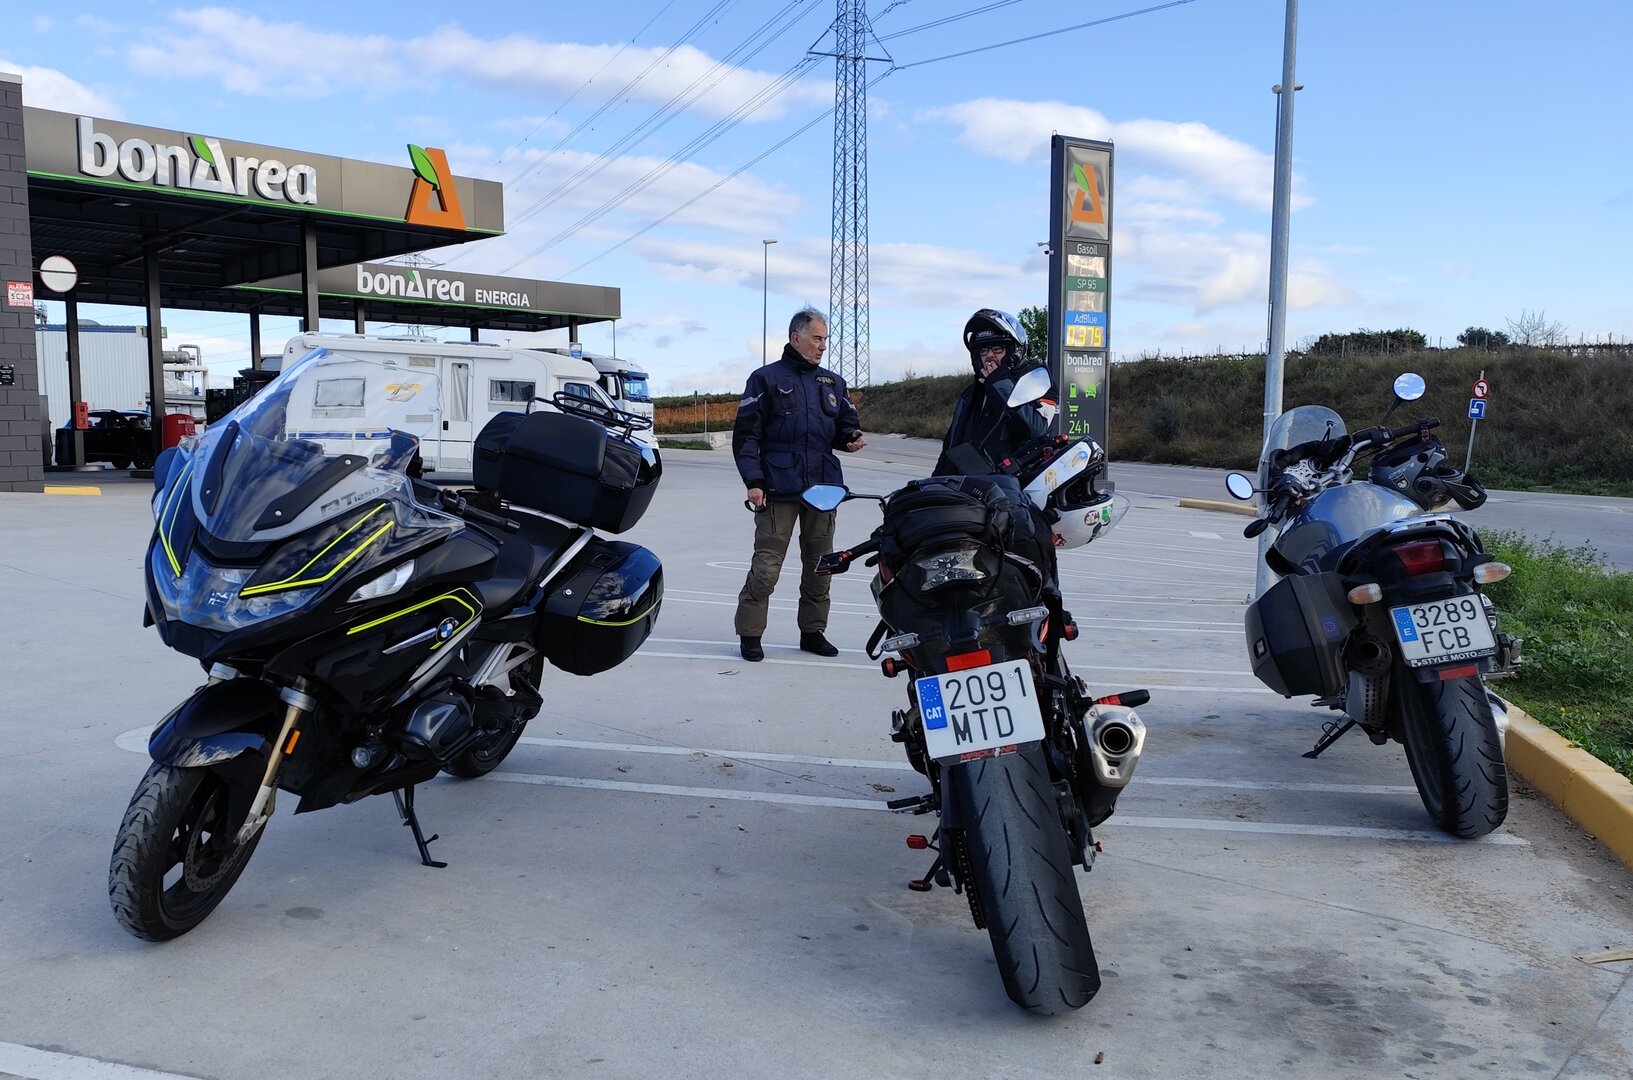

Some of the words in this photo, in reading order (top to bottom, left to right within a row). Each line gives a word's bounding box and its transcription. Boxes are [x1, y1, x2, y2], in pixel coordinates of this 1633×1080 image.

[76, 115, 318, 206] bonArea
[1076, 243, 1098, 255] Gasoil
[356, 263, 465, 302] bonArea
[475, 288, 531, 308] ENERGIA
[1077, 279, 1087, 289] SP
[1087, 279, 1097, 290] 95
[1074, 313, 1098, 325] AdBlue
[1066, 353, 1103, 366] bonArea
[1068, 420, 1082, 434] 24
[1083, 419, 1090, 434] h
[1412, 599, 1477, 629] 3289
[1403, 628, 1412, 636] E
[1420, 626, 1471, 654] FCB
[1421, 655, 1449, 665] STYLE
[1450, 651, 1478, 661] MOTO
[945, 666, 1027, 710] 2091
[926, 706, 943, 720] CAT
[951, 705, 1015, 746] MTD
